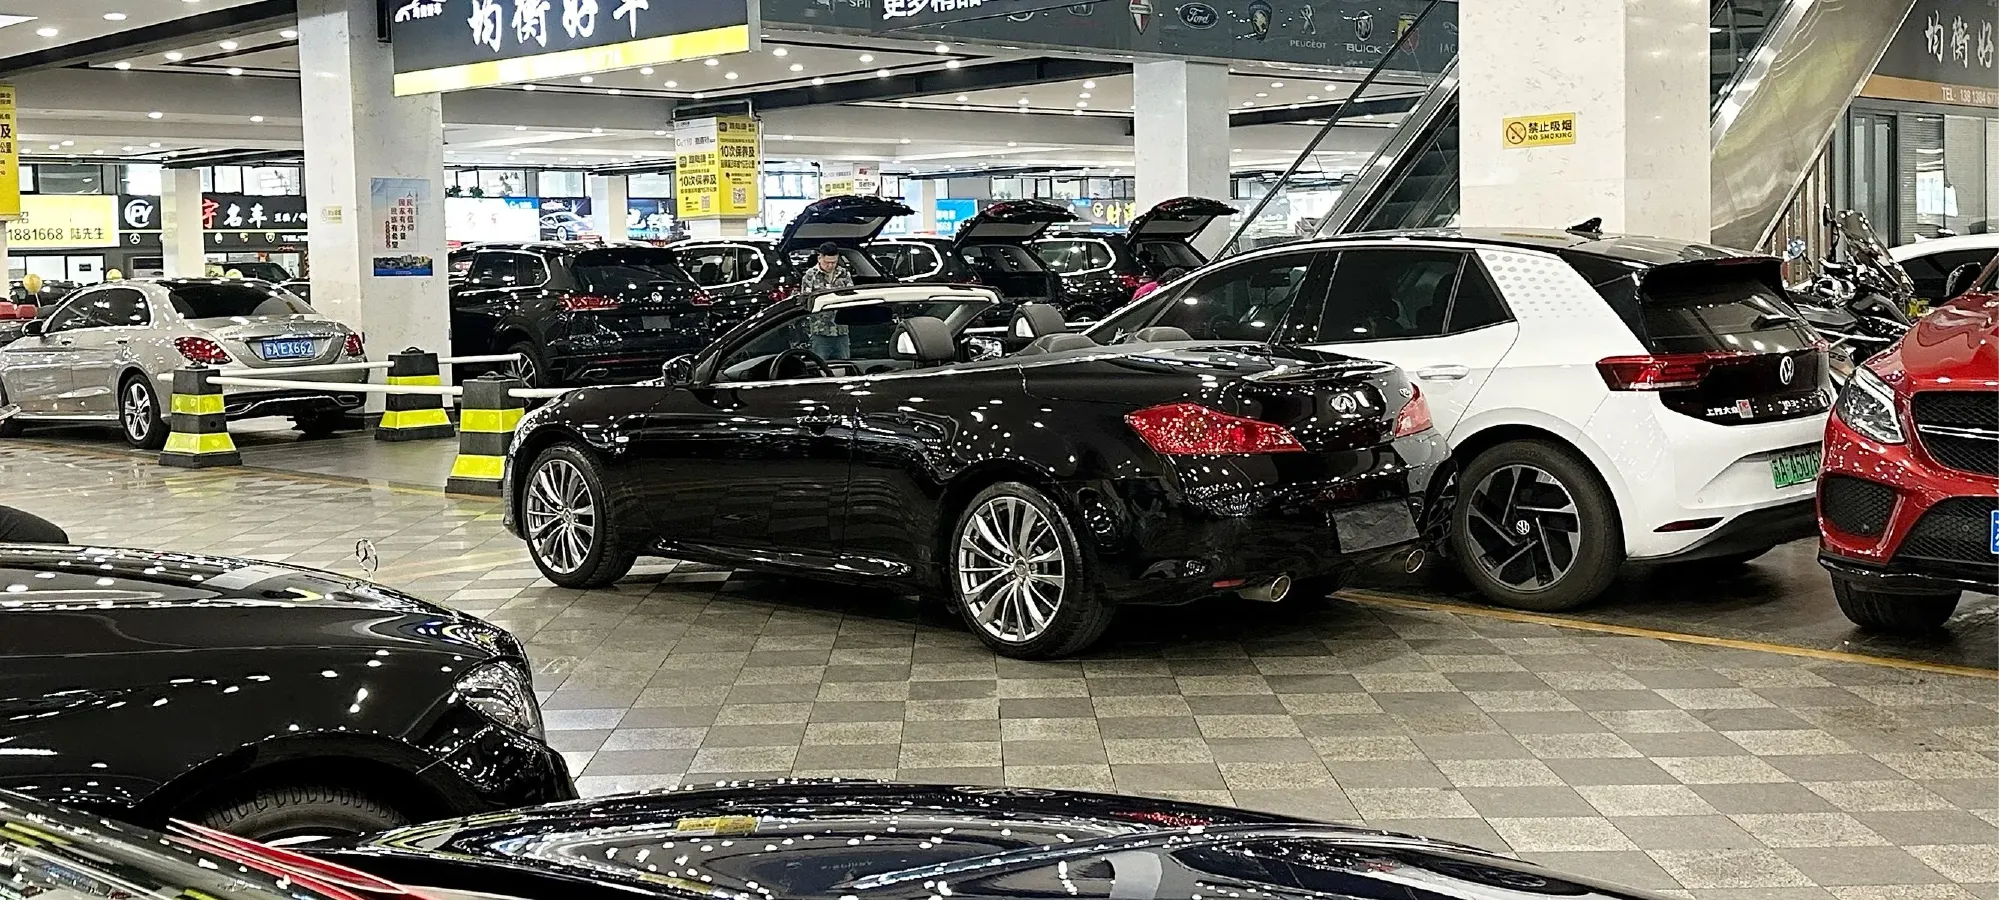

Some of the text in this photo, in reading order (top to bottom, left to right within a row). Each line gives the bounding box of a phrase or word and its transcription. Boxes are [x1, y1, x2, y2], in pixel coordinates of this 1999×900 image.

[1187, 7, 1210, 23] Ford
[1290, 39, 1327, 49] PEUGEOT
[1346, 43, 1383, 54] BUICK
[1528, 119, 1572, 133] 禁止吸烟
[1540, 131, 1572, 139] SMOKING
[8, 227, 104, 241] 1881668 陆先生
